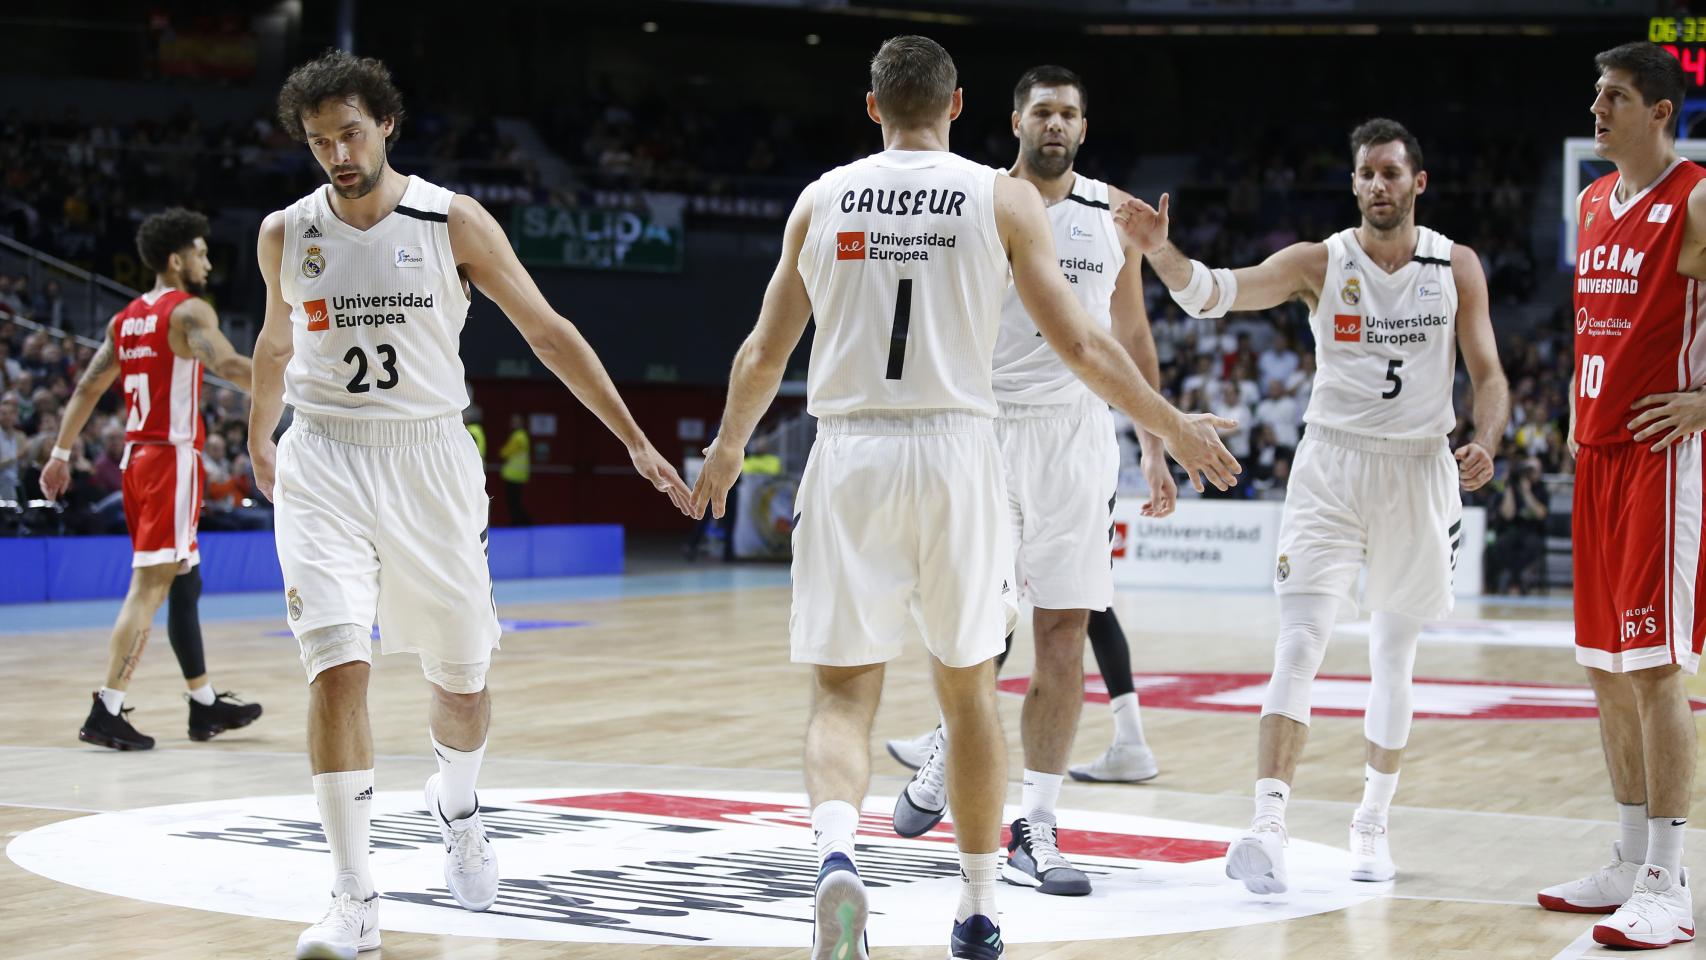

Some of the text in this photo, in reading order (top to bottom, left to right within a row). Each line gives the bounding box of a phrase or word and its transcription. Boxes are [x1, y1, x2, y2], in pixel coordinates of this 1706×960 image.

[840, 187, 967, 217] CAUSEUR
[870, 231, 957, 249] Universidad
[869, 247, 929, 264] Europea
[1578, 244, 1646, 278] UCAM
[1059, 257, 1104, 274] rsidad
[332, 292, 434, 311] Universidad
[334, 312, 407, 329] Europea
[885, 278, 913, 381] 1
[1589, 317, 1632, 329] Costa Cálida
[1366, 331, 1427, 347] Europea
[342, 343, 400, 394] 23
[1580, 353, 1605, 399] 10
[1381, 359, 1404, 400] 5
[1136, 522, 1262, 542] Universidad
[1135, 545, 1223, 563] Europea
